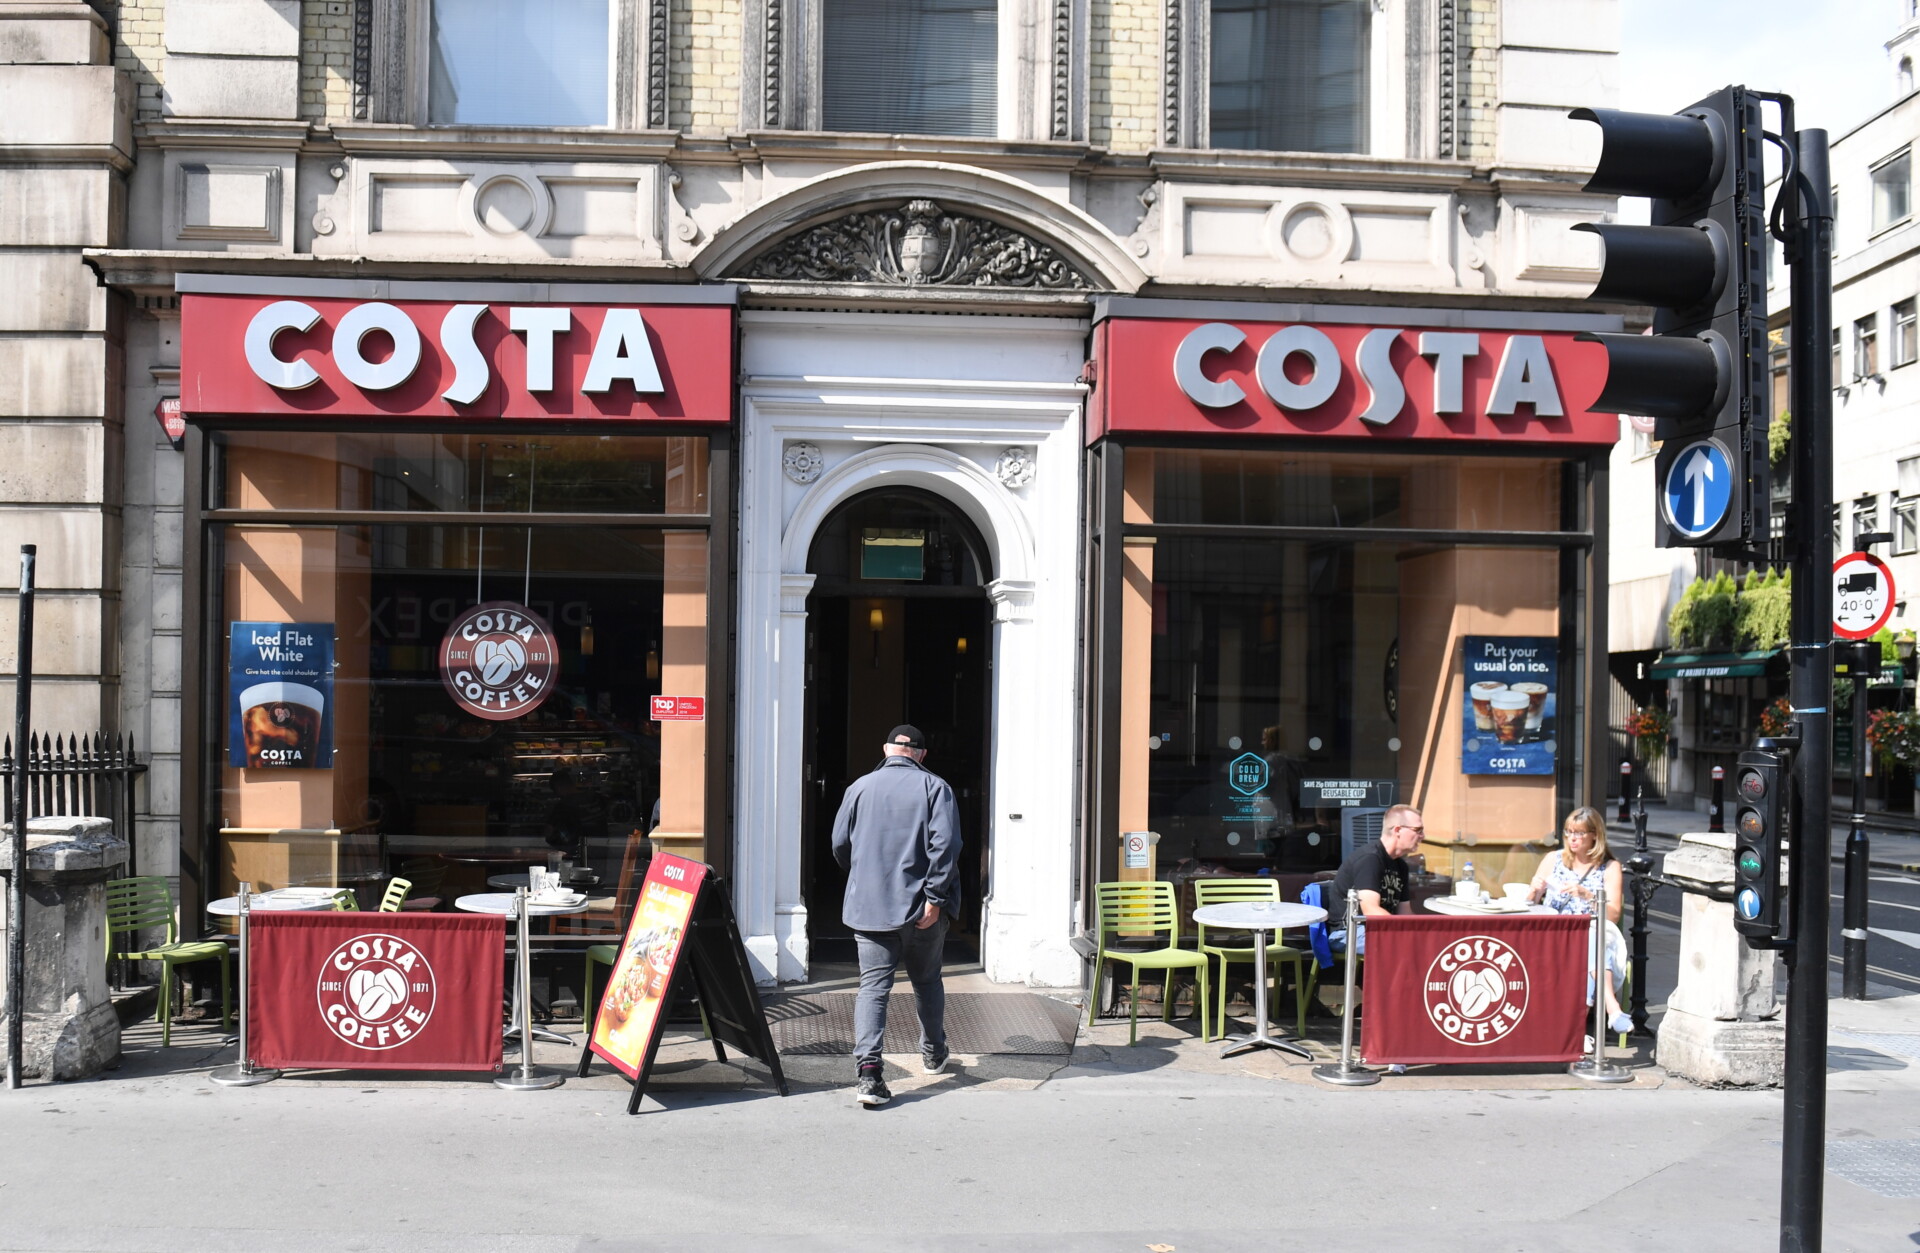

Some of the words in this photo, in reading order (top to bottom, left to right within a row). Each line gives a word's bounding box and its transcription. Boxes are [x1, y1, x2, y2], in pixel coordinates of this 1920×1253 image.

[244, 300, 665, 405] COSTA
[1172, 322, 1564, 426] COSTA
[462, 612, 534, 643] COSTA
[252, 630, 281, 646] Iced
[285, 631, 313, 646] Flat
[259, 646, 304, 662] White
[450, 651, 468, 660] SINCE
[531, 652, 546, 661] 1971
[1484, 643, 1507, 657] Put
[1509, 647, 1538, 662] your
[1474, 658, 1507, 671] usual
[1508, 663, 1525, 672] on
[1528, 659, 1549, 672] ice.
[455, 670, 542, 708] COFFEE
[654, 698, 674, 710] top
[260, 749, 302, 761] COSTA
[1239, 765, 1259, 774] COLD
[1489, 758, 1526, 769] COSTA
[1239, 775, 1259, 783] BREW
[1322, 789, 1351, 797] REUSABLE
[1353, 789, 1365, 797] CUP
[663, 864, 685, 881] COSTA
[334, 938, 418, 974] COSTA
[1440, 939, 1513, 973] COSTA
[321, 981, 342, 992] SINCE
[412, 982, 429, 993] 1971
[1428, 981, 1447, 992] SINCE
[1508, 981, 1523, 991] 1971
[326, 1003, 426, 1046] COFFEE
[1433, 1001, 1521, 1042] COFFEE
